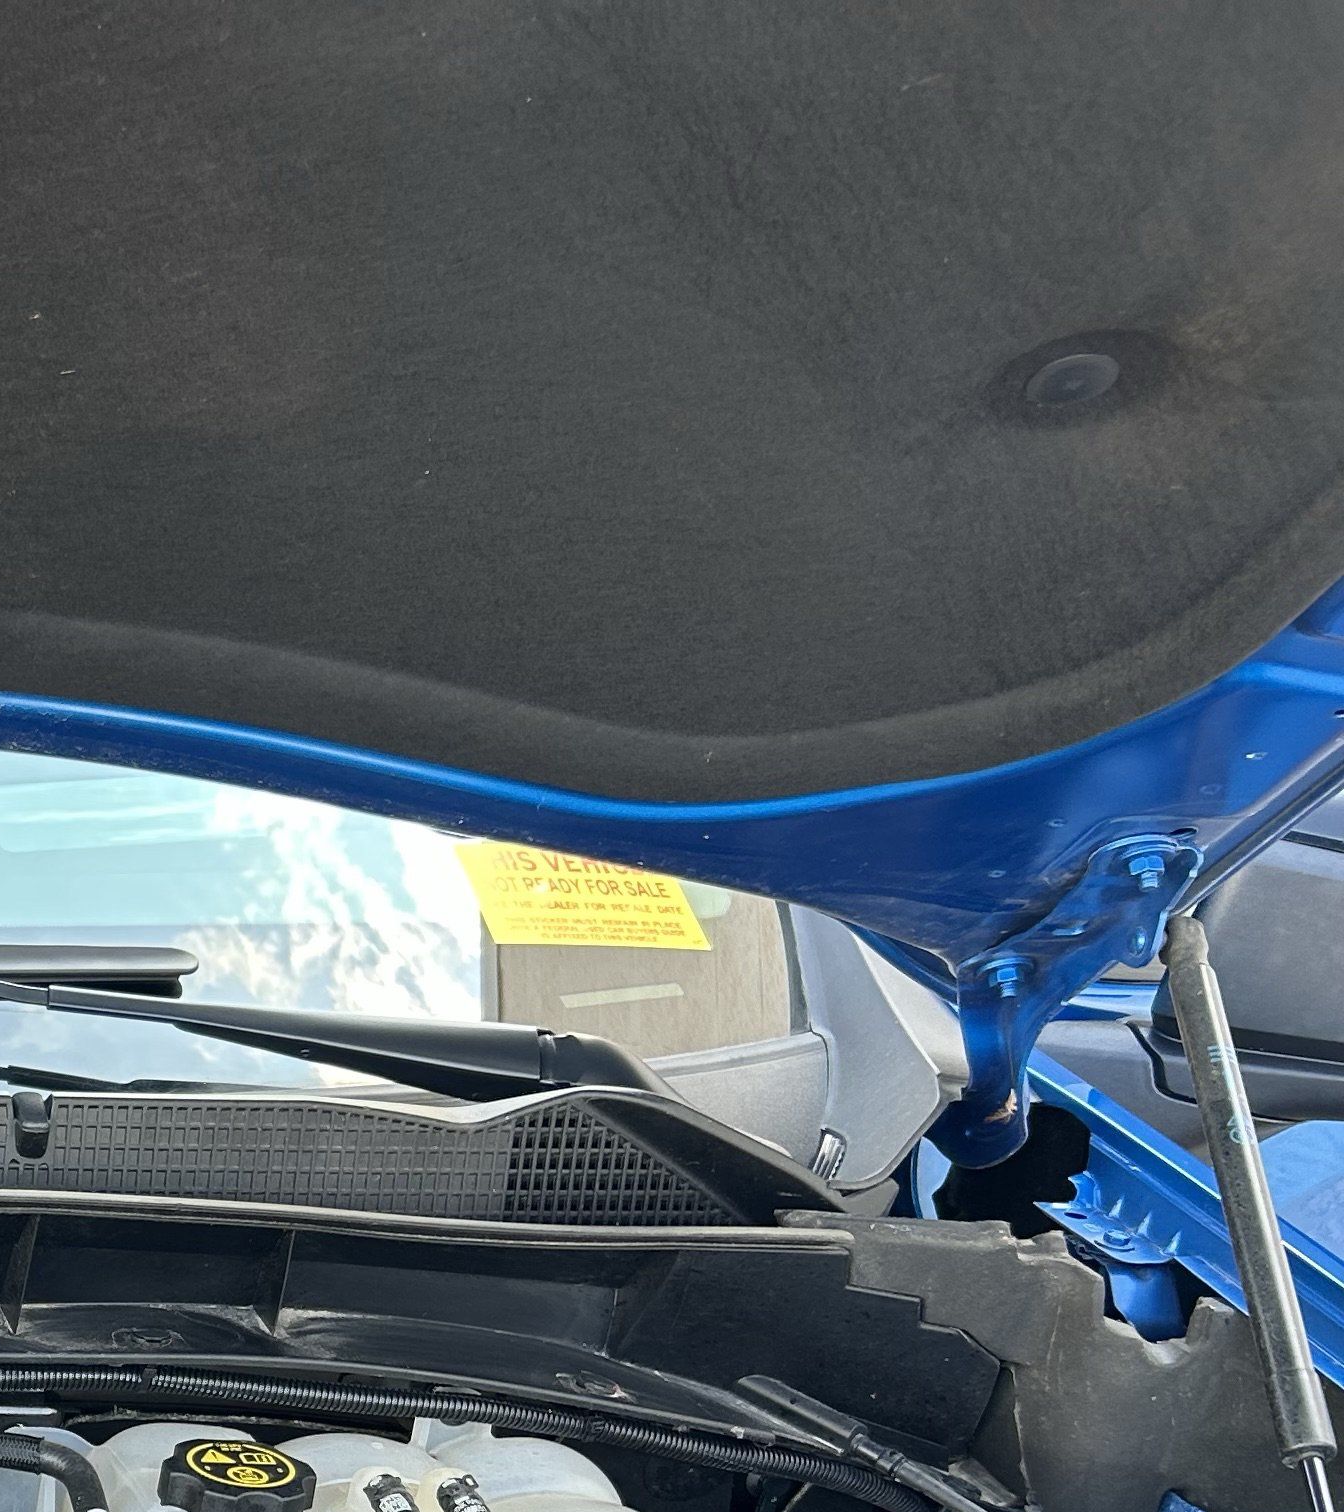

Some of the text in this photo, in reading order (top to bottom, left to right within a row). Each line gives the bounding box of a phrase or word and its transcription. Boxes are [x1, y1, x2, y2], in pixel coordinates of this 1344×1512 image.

[490, 851, 537, 871] HIS
[523, 878, 582, 894] READY
[585, 879, 623, 896] FOR
[625, 881, 671, 898] SALE
[540, 901, 579, 910] EALER
[584, 902, 606, 911] FOR
[657, 905, 685, 915] DATE
